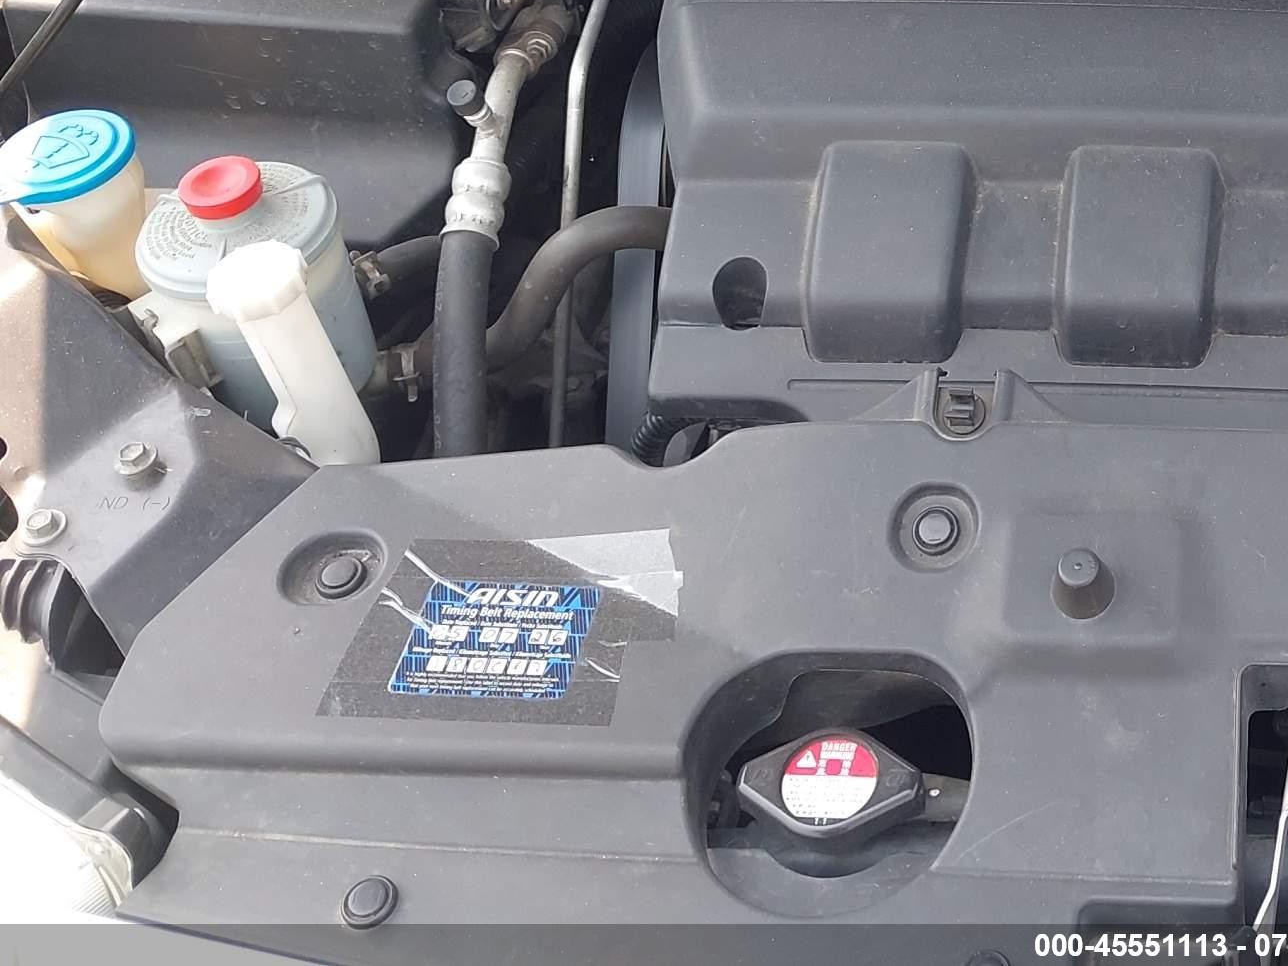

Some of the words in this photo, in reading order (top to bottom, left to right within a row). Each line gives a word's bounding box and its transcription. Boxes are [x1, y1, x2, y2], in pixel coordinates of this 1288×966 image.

[466, 587, 560, 606] AISIN
[441, 605, 478, 619] Timing
[480, 607, 502, 618] Belt
[503, 608, 574, 622] Replacement
